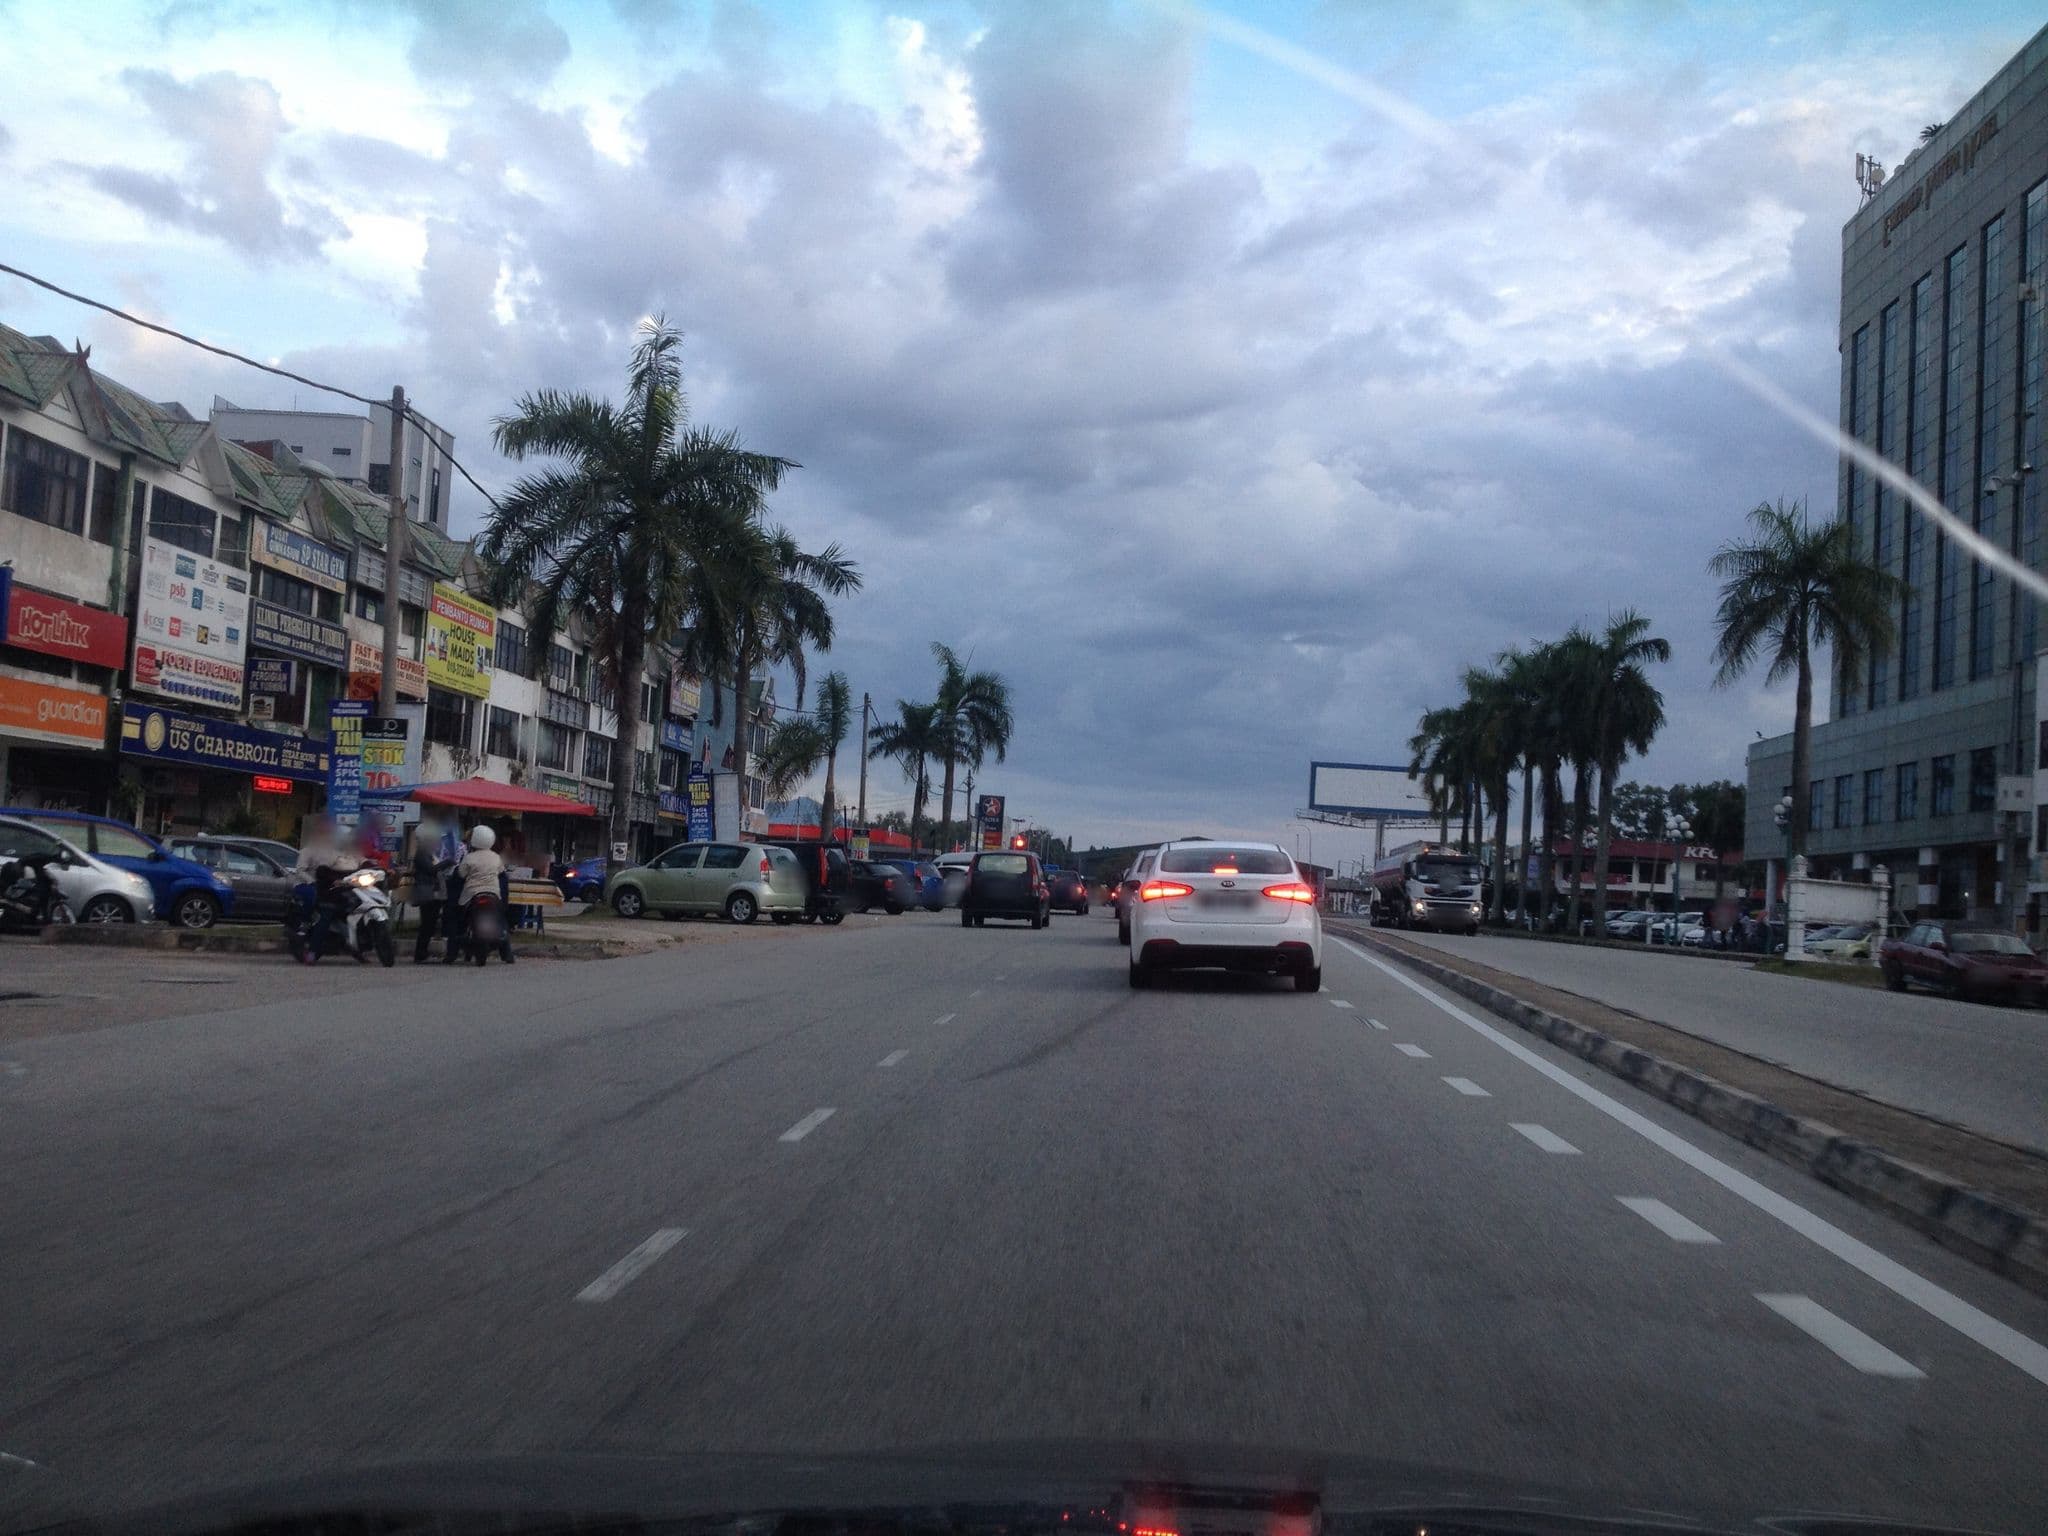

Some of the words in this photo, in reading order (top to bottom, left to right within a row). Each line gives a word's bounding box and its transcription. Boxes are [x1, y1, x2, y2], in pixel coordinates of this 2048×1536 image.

[311, 549, 329, 573] STAR
[330, 556, 345, 579] GYM
[170, 583, 186, 599] psb
[256, 606, 279, 630] KLINIK
[436, 601, 469, 623] PEMBANTU
[469, 612, 490, 632] RUMAH
[450, 622, 476, 646] HOUSE
[354, 644, 372, 659] FAST
[450, 643, 475, 665] MAIDS
[161, 650, 193, 672] FOCUS
[194, 659, 244, 684] EDUCATION
[38, 699, 102, 725] guardian
[331, 716, 362, 731] MATT
[169, 729, 191, 751] US
[194, 734, 279, 766] CHARBROIL
[364, 748, 405, 765] STOK
[336, 769, 360, 777] SPIC
[337, 759, 360, 768] Seti
[334, 778, 360, 787] Aren
[1684, 846, 1719, 859] KFC
